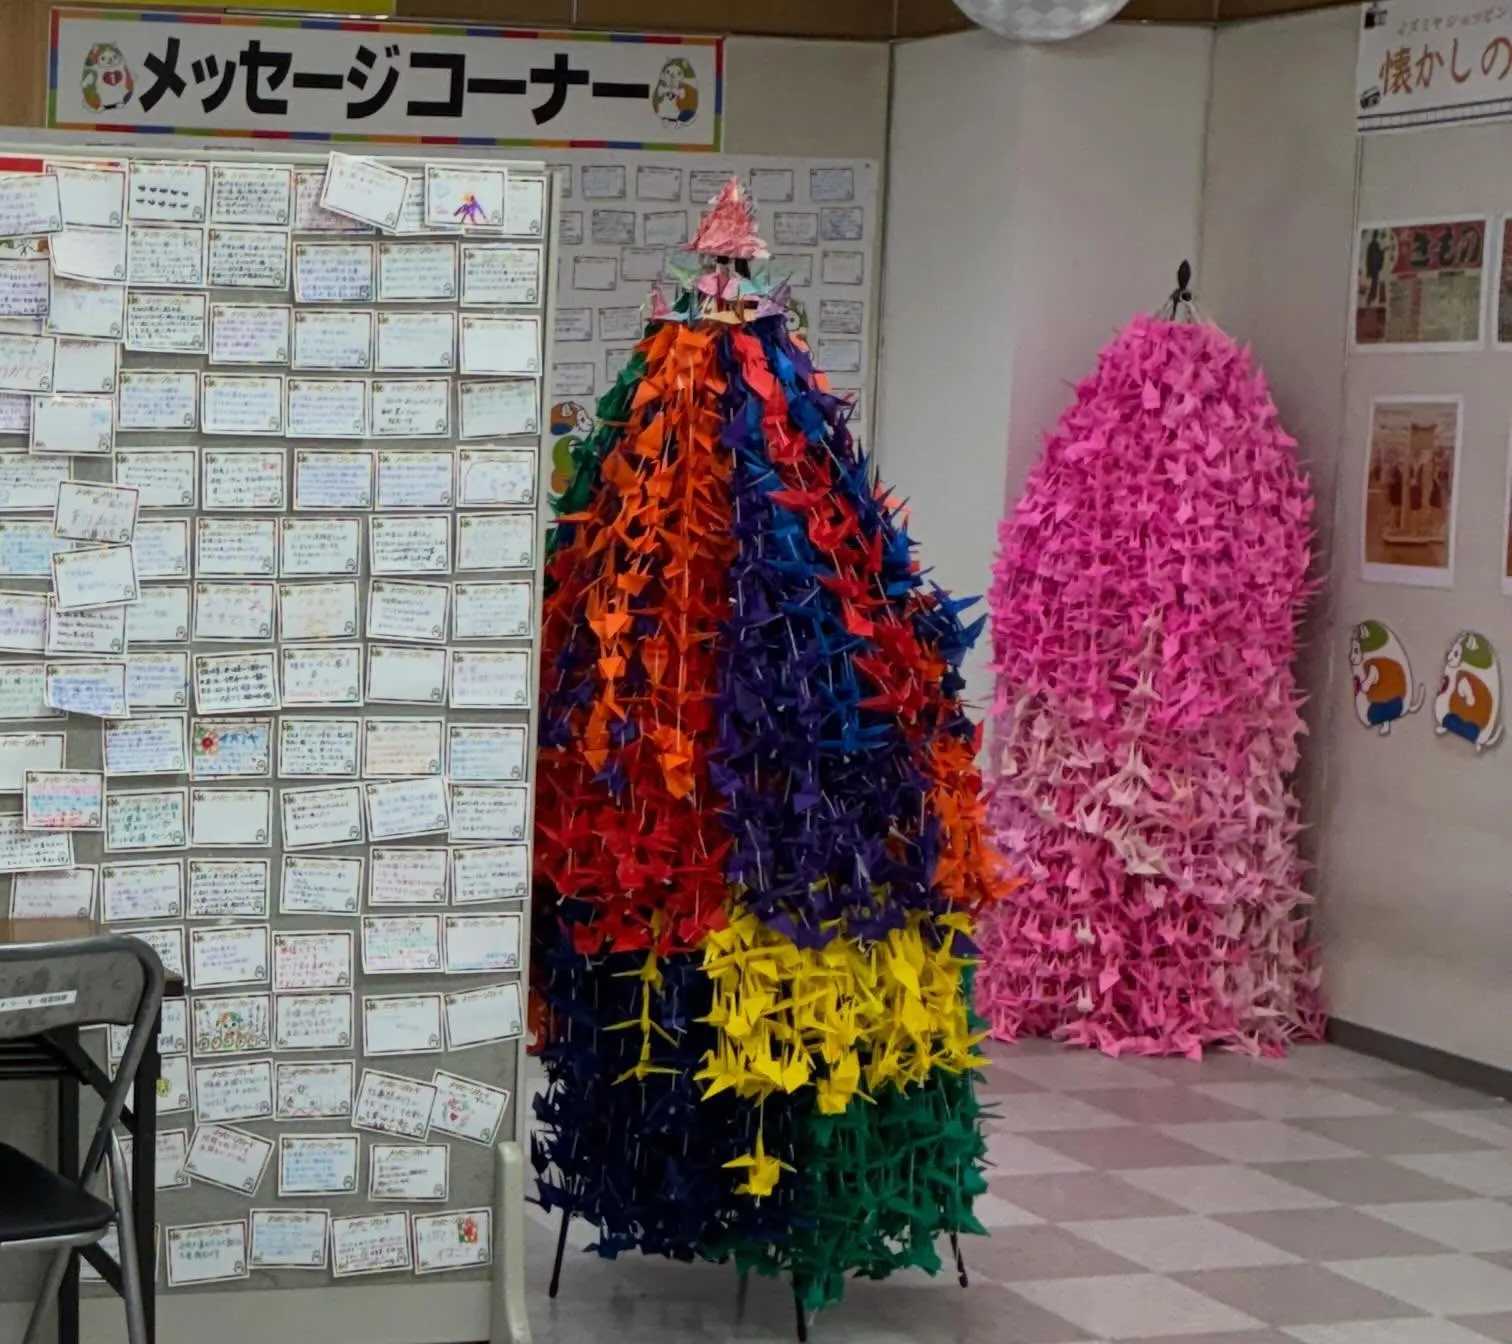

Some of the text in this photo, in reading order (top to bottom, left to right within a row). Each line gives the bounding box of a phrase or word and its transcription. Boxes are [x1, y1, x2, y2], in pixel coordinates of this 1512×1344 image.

[140, 38, 649, 125] メッセージコーナー
